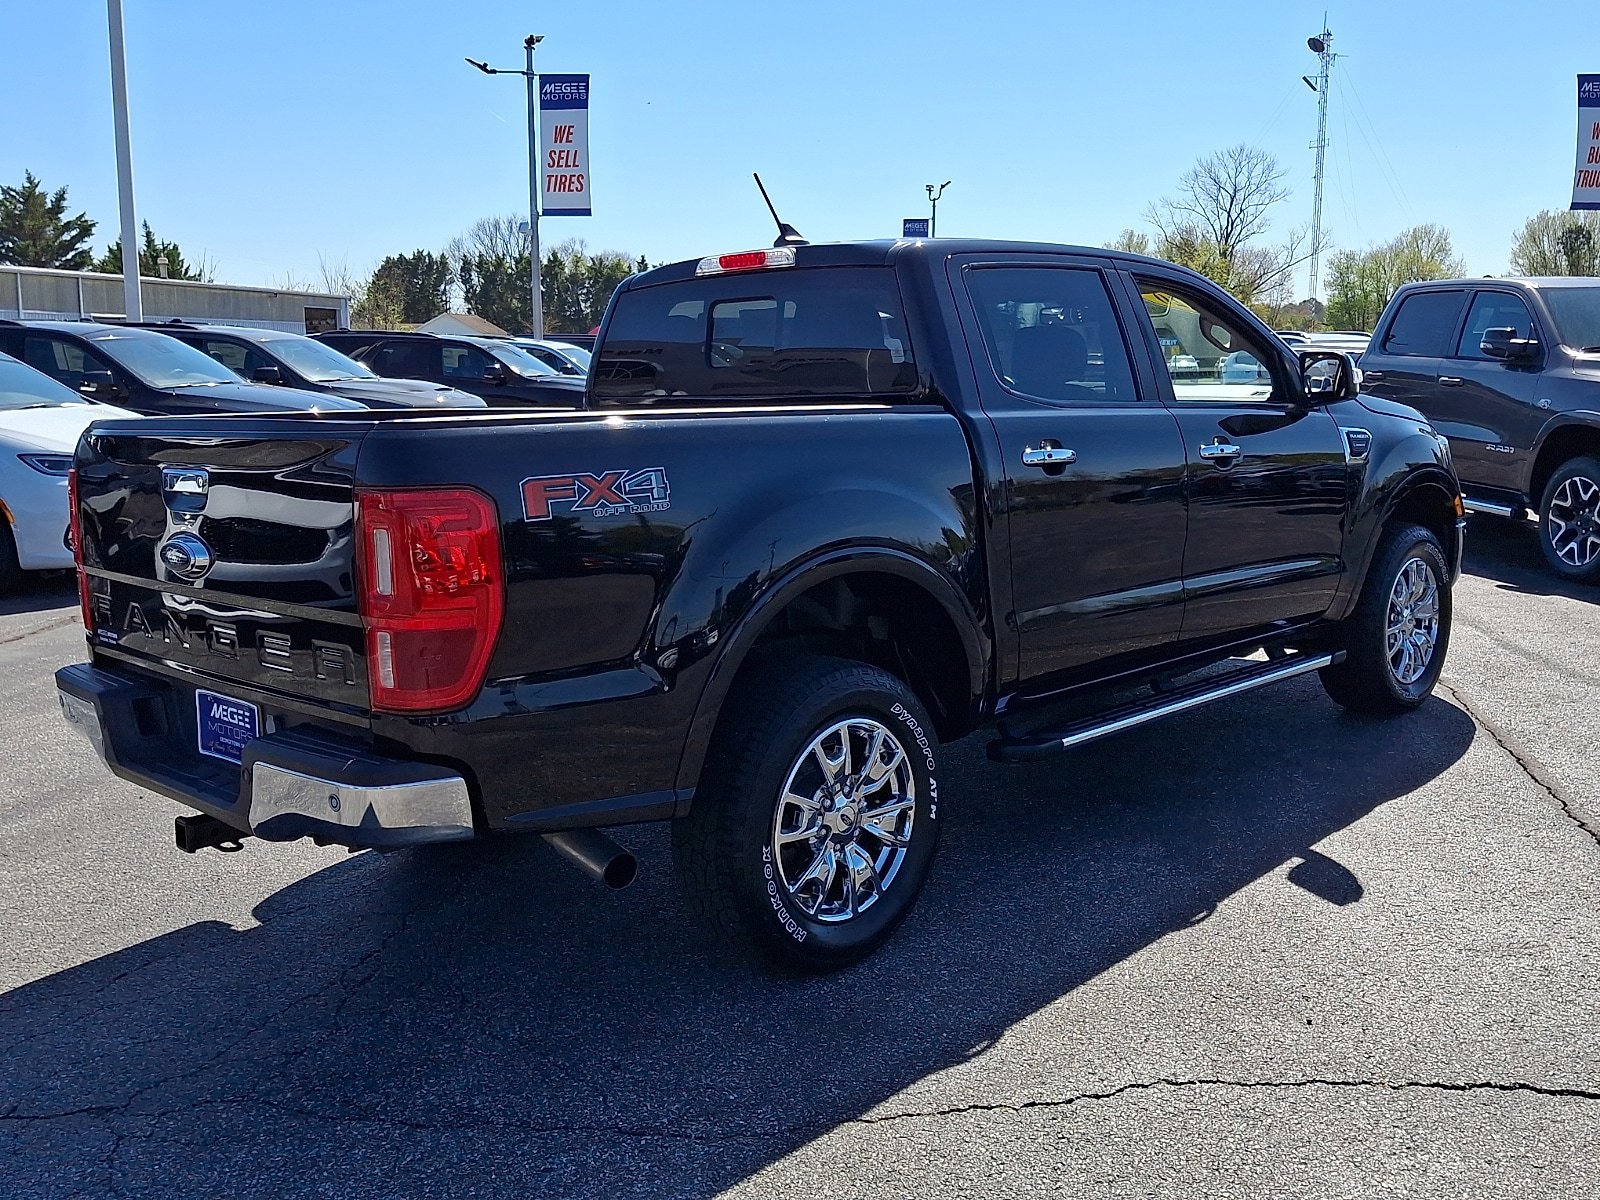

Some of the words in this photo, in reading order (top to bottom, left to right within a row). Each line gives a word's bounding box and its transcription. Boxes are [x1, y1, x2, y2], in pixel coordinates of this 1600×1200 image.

[541, 93, 587, 101] MOTORS
[542, 83, 587, 93] MEGEE
[553, 125, 575, 144] WE
[547, 149, 579, 169] SELL
[546, 173, 585, 193] TIRES
[519, 466, 671, 523] FX4
[593, 505, 626, 518] OFF
[629, 502, 671, 514] ROAD
[92, 591, 357, 686] RANGER
[210, 702, 252, 729] MEGEE
[207, 720, 254, 742] MOTORS
[890, 702, 936, 771] Dynapro
[762, 844, 807, 943] Hankook
